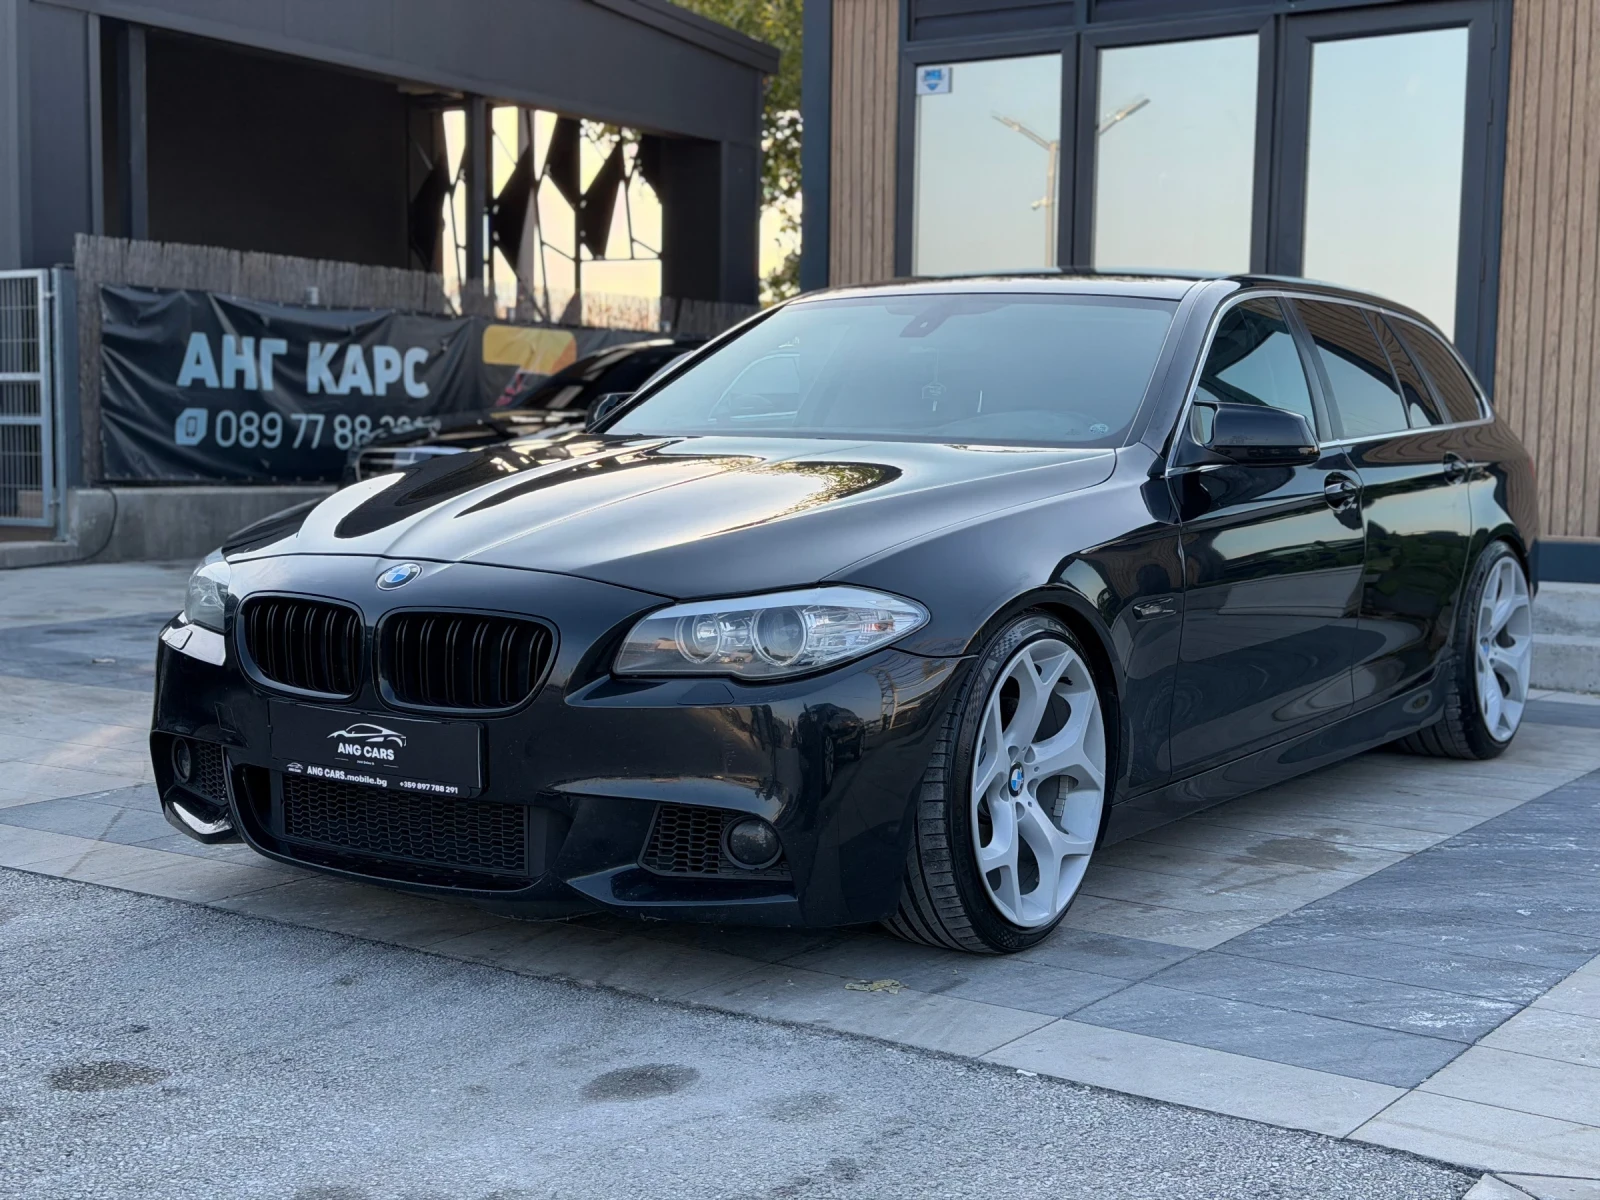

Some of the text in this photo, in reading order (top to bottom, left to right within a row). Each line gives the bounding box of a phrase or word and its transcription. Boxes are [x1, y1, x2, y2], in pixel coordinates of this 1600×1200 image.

[176, 331, 430, 399] АНГ КАРС
[215, 409, 283, 448] 089
[290, 413, 325, 449] 77
[337, 742, 395, 761] ANG CARS
[307, 765, 388, 787] ANG CARS.mobile.bg
[399, 780, 459, 794] +359 897 788 291
